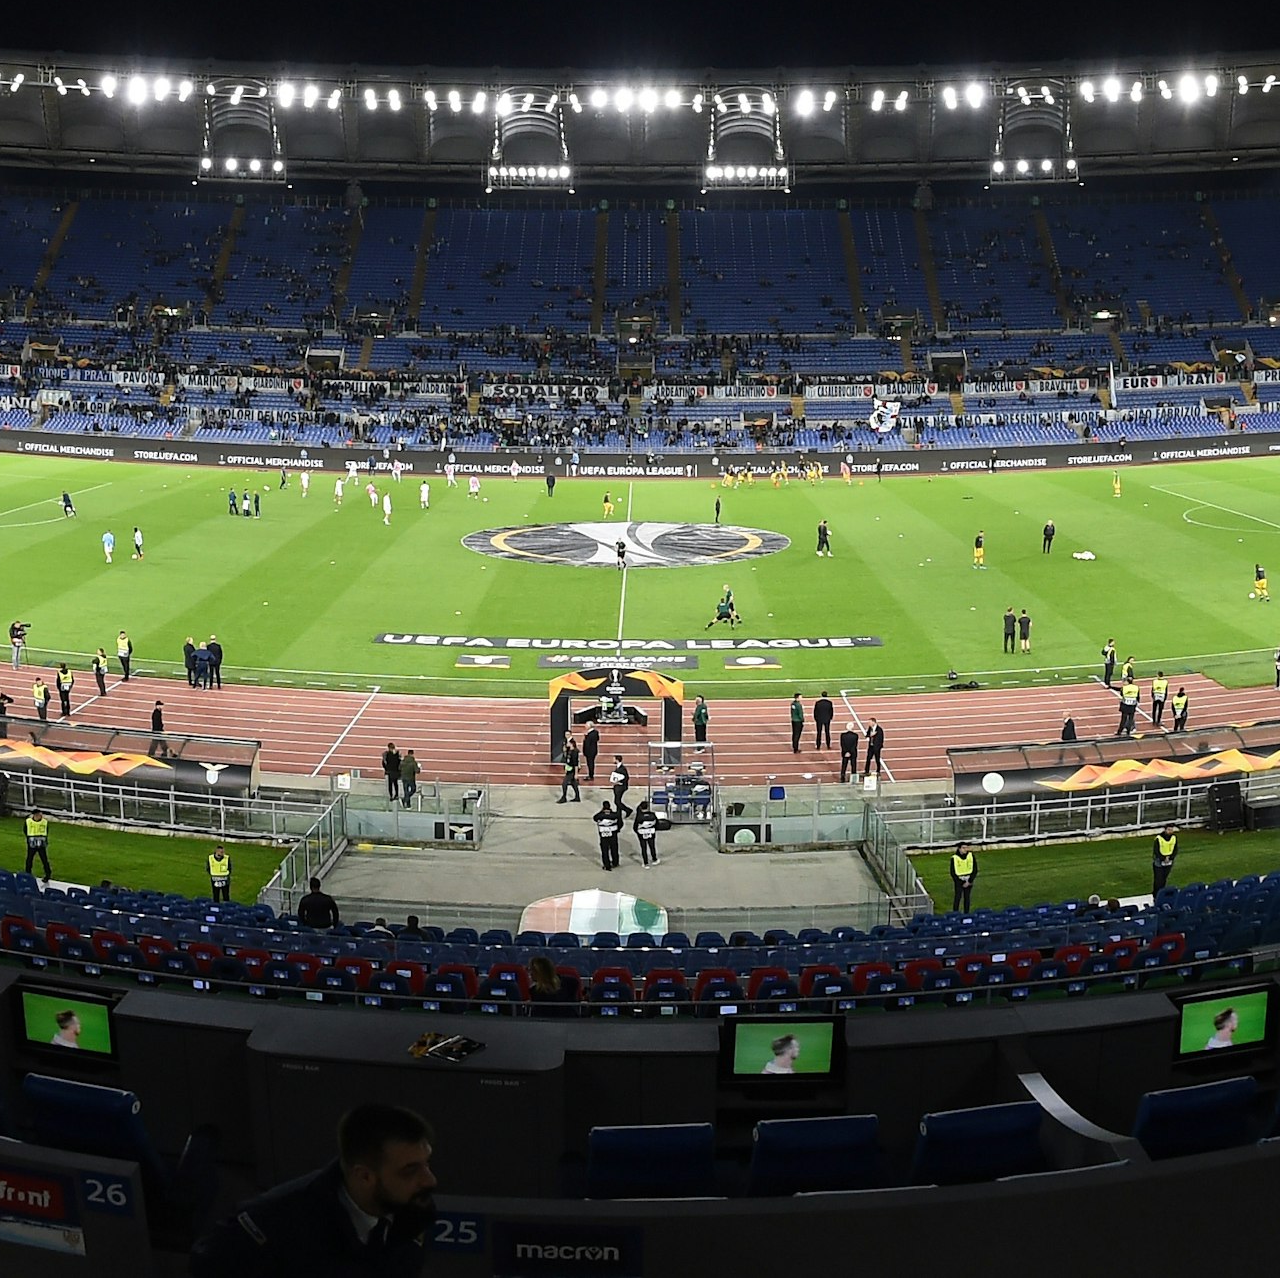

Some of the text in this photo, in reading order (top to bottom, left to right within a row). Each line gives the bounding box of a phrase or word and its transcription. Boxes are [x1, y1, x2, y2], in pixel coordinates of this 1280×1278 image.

[1039, 379, 1078, 392] BRAVETTA
[1123, 378, 1149, 389] EUR
[724, 386, 766, 397] LAURENTINO
[1156, 406, 1201, 420] FABRIZIO
[25, 443, 114, 457] OFFICIAL MERCHANDISE
[1161, 446, 1250, 459] OFFICIAL MERCHANDISE
[227, 455, 324, 468] OFFICIAL MERCHANDISE
[950, 461, 987, 470] OFFICIAL
[484, 465, 544, 474] MERCHNDISE
[580, 467, 683, 475] UEFA EUROPA LEAGUE
[384, 633, 494, 647] UEFA
[506, 638, 676, 650] EUROPA
[86, 1178, 127, 1207] 26
[434, 1219, 478, 1245] 25
[515, 1241, 620, 1262] macron
